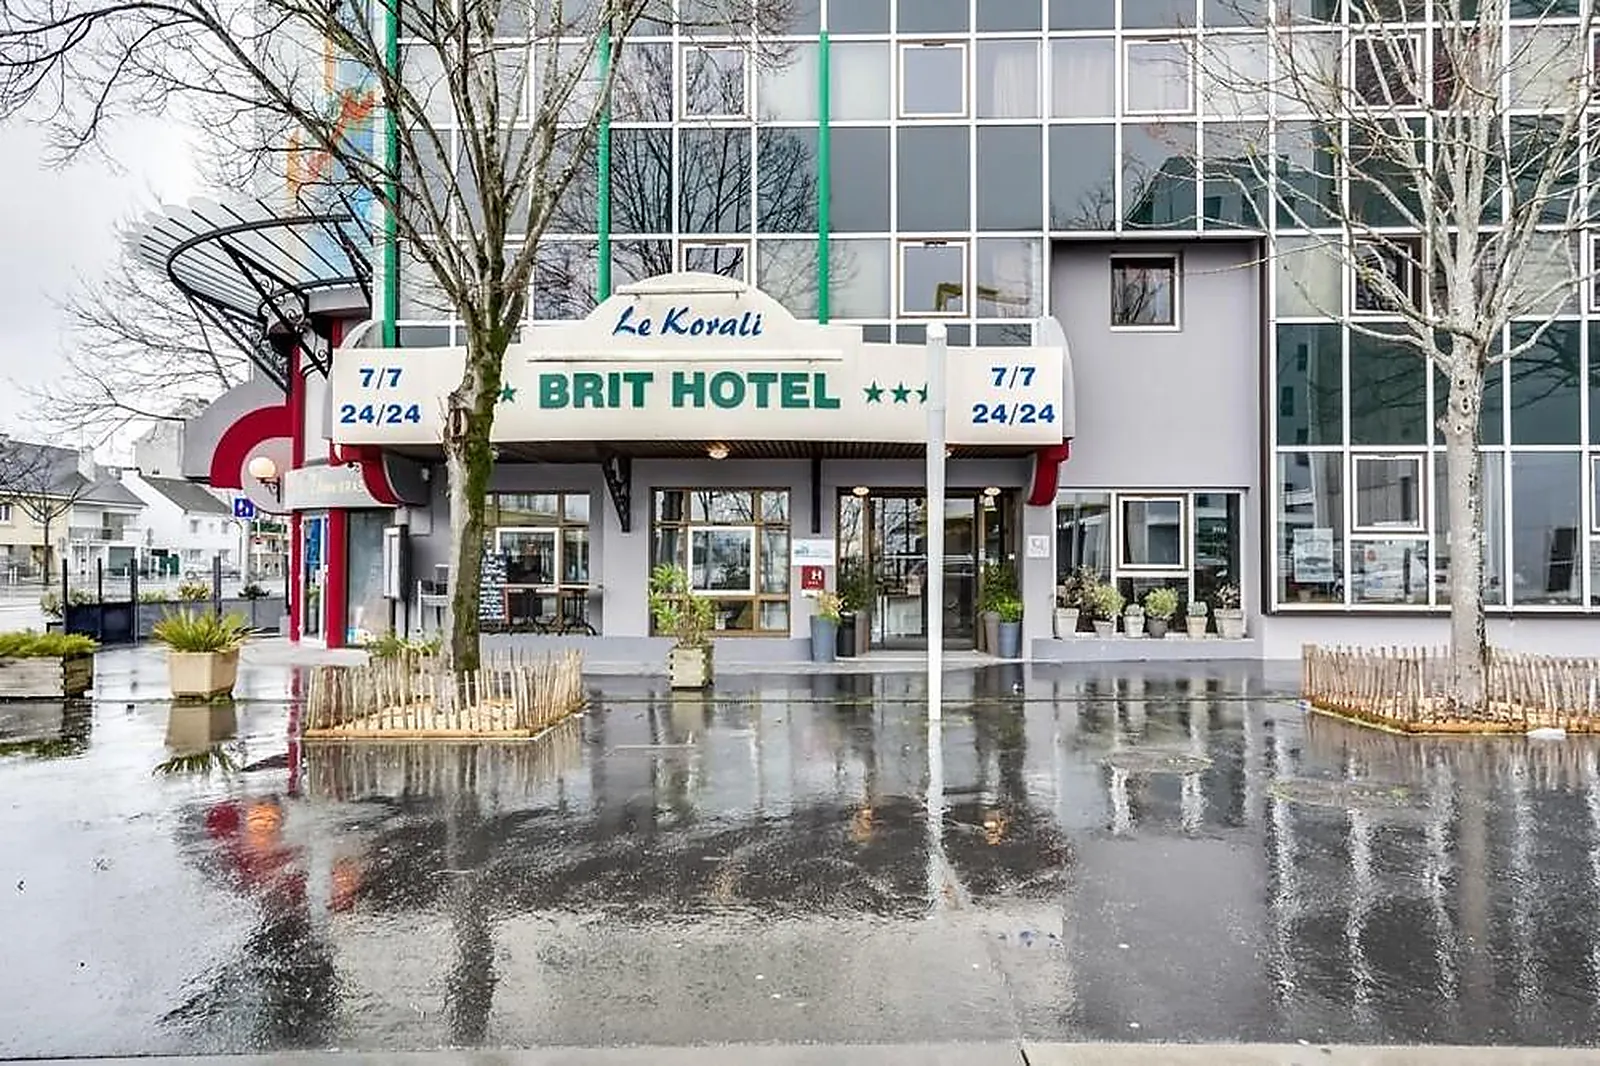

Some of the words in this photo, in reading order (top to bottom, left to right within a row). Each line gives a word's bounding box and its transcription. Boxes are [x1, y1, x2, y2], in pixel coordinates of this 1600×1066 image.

[612, 305, 651, 338] Le
[661, 306, 763, 338] Korali
[359, 367, 403, 390] 7/7
[538, 371, 653, 409] BRIT
[671, 370, 841, 410] HOTEL
[991, 366, 1036, 390] 7/7
[340, 404, 421, 427] 24/24
[972, 403, 1056, 427] 24/24
